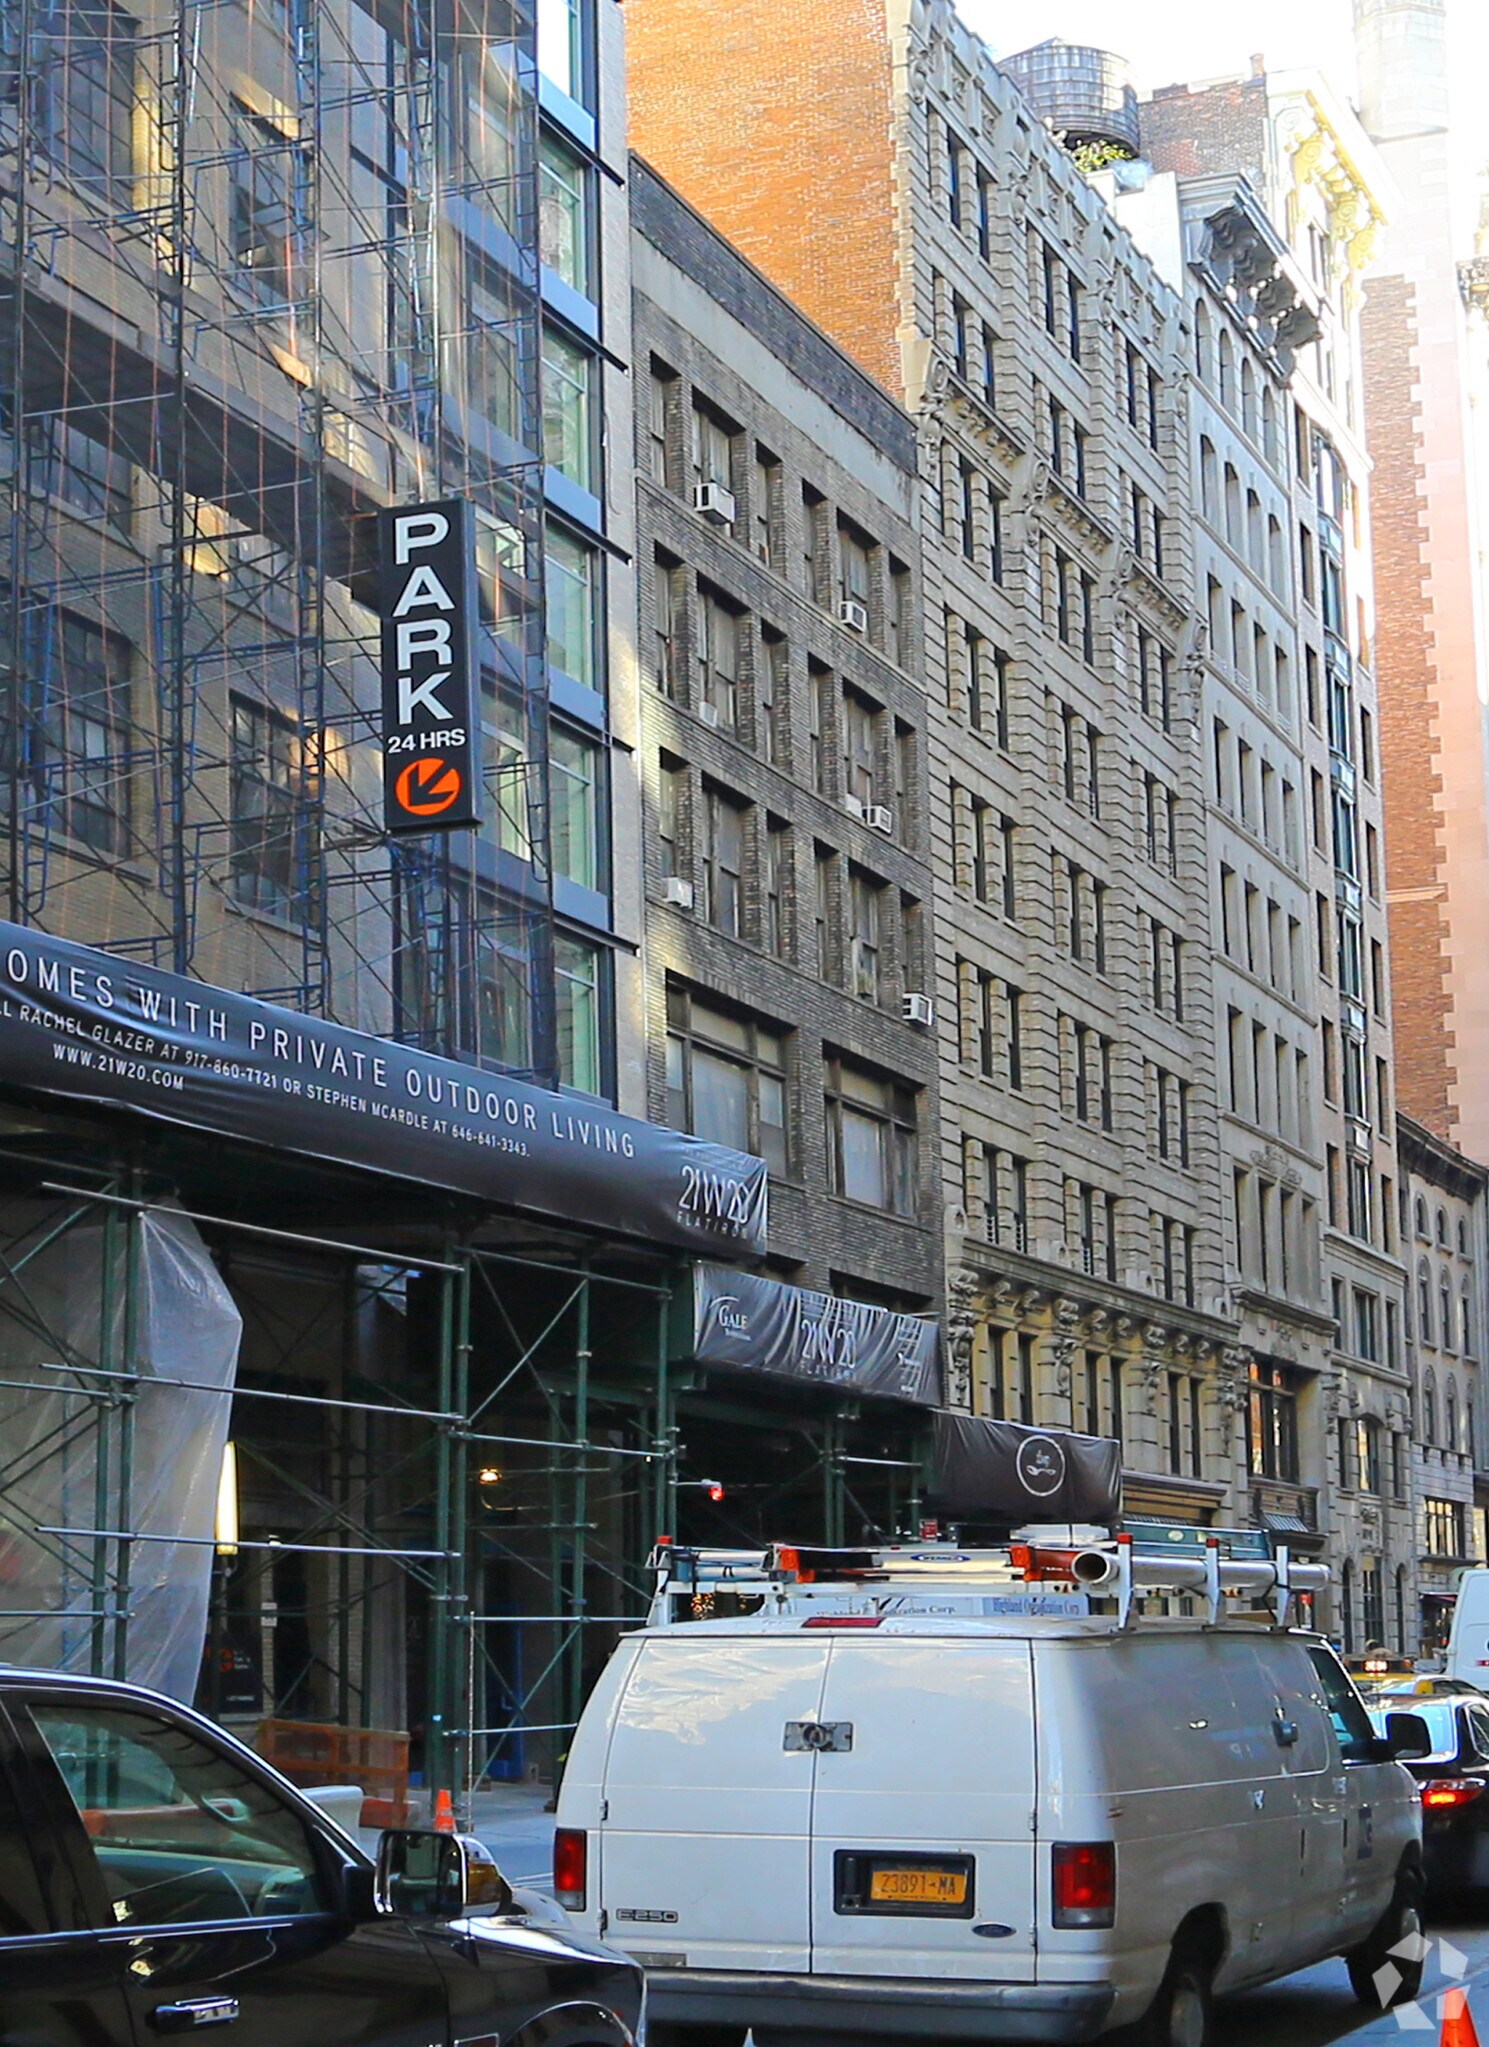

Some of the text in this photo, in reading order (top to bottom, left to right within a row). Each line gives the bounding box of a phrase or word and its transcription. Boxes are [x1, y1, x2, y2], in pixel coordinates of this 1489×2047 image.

[392, 511, 455, 725] PARK
[388, 728, 466, 754] 24 HRS
[8, 948, 635, 1158] OMES WITH PRIVATE OUTDOOR LIVING
[20, 1005, 86, 1037] RACHEL
[92, 1024, 155, 1054] GLAZER
[160, 1044, 179, 1060] AT
[185, 1050, 277, 1088] 917-860-7721
[283, 1078, 301, 1095] OR
[306, 1084, 367, 1112] STEPHEN
[372, 1102, 428, 1130] MCARDLE
[433, 1119, 448, 1134] AT
[52, 1043, 184, 1090] WWW.21W20.COM
